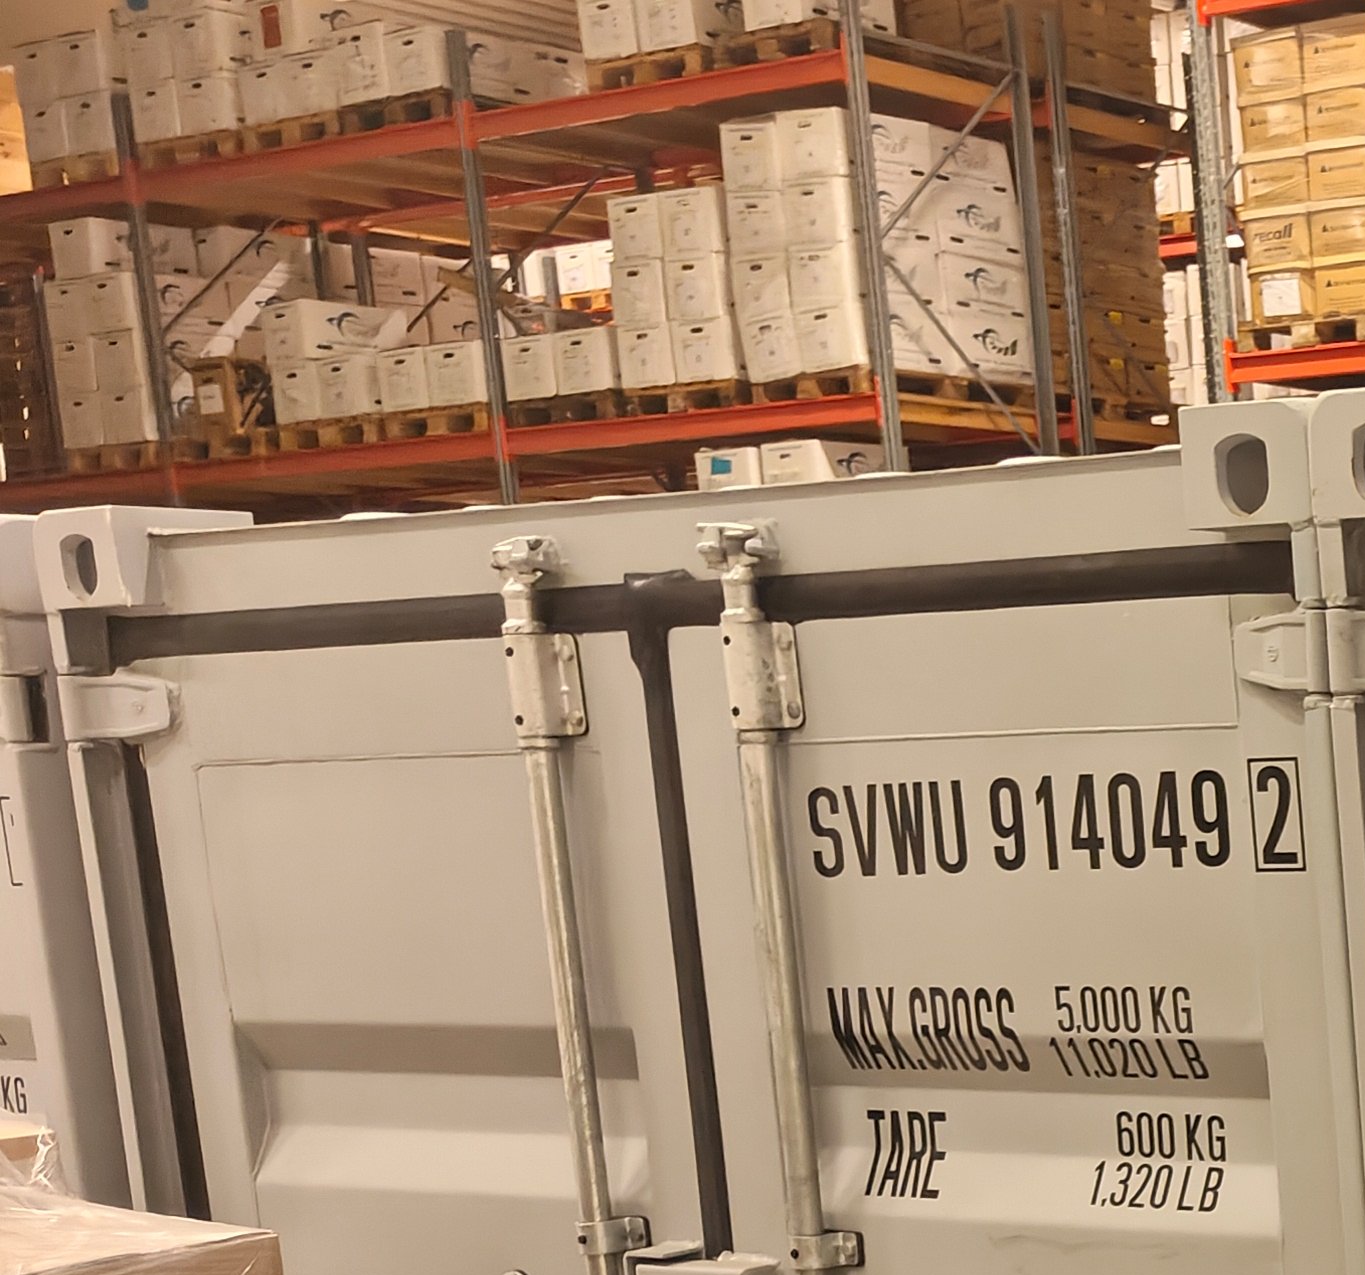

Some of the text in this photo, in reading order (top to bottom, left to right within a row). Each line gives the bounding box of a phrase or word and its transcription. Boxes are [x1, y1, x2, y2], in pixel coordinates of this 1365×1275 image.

[1253, 222, 1293, 242] recall
[807, 765, 1299, 878] SVWU 914049 2
[827, 986, 1030, 1073] MAX.GROSS
[1149, 986, 1193, 1034] KG
[1155, 1038, 1209, 1080] LB
[0, 1075, 28, 1115] KG
[864, 1110, 948, 1200] TARE
[1116, 1110, 1227, 1162] 600 KG
[1176, 1165, 1225, 1213] LB
